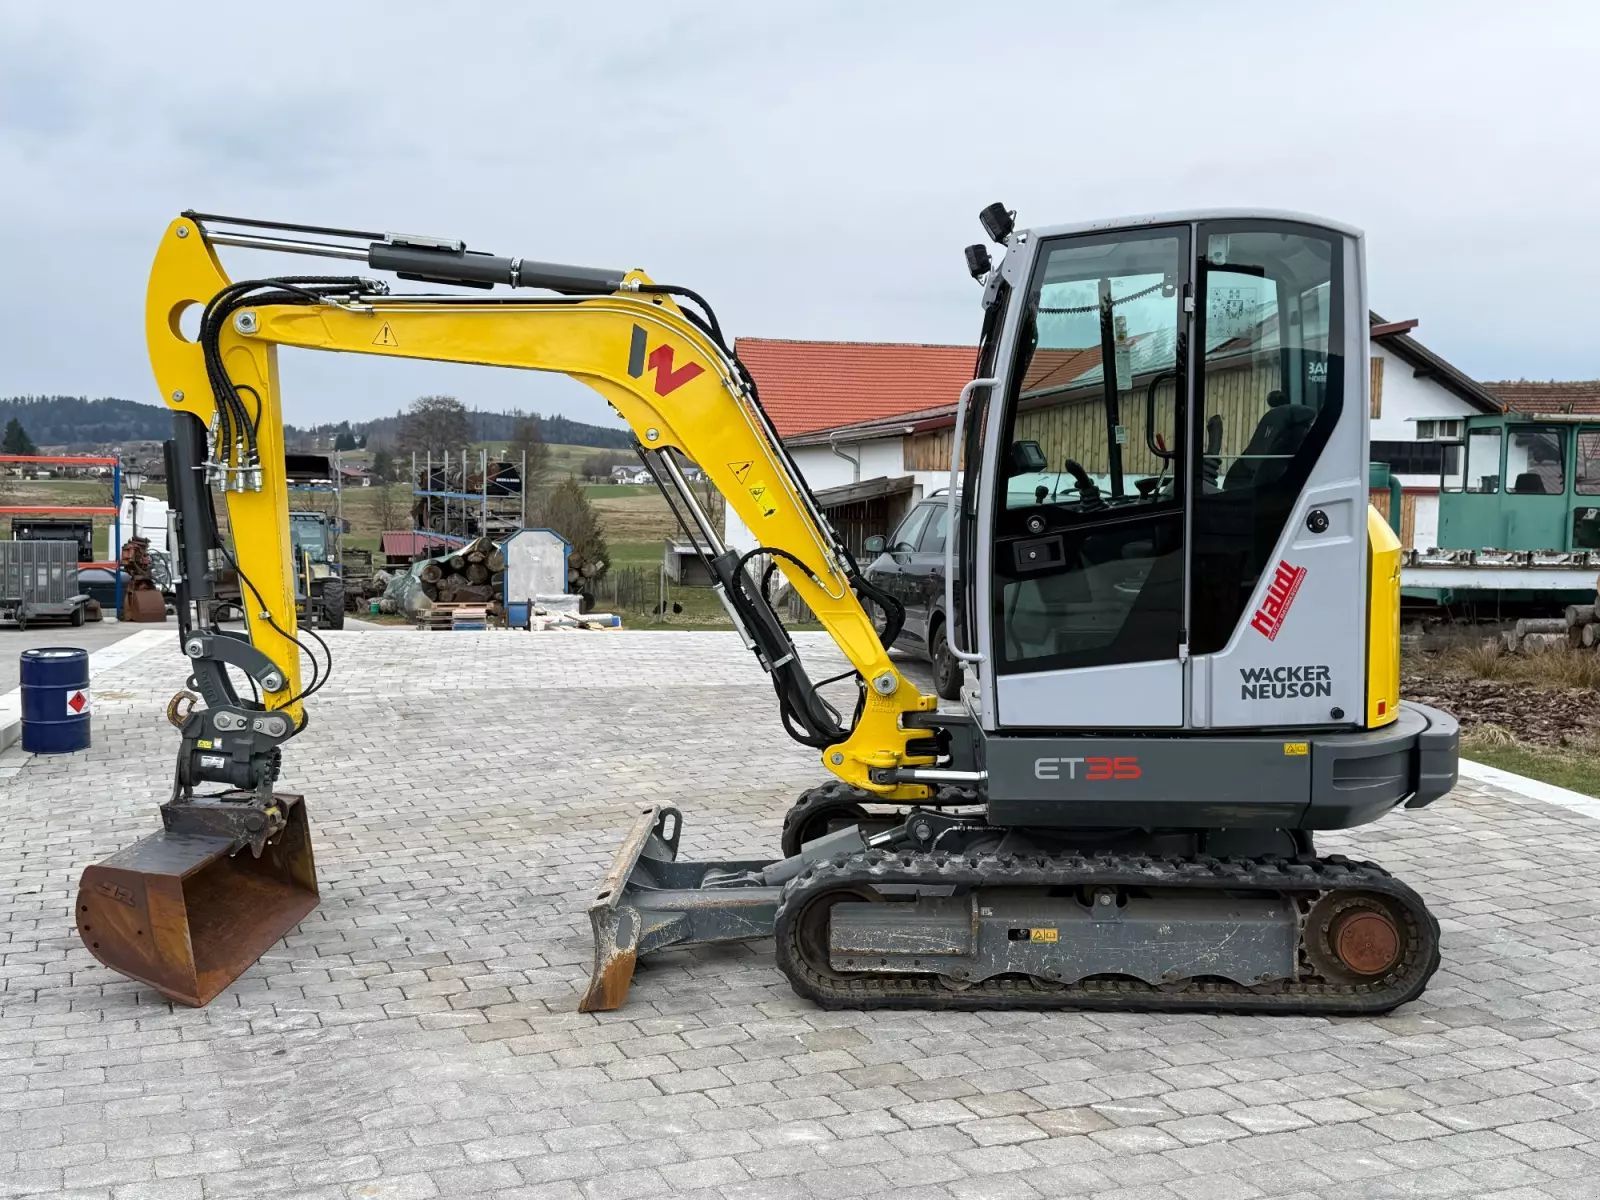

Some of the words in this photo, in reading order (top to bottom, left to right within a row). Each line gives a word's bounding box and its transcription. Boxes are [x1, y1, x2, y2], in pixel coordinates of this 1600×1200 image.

[1240, 665, 1331, 683] WACKER
[1242, 681, 1331, 700] NEUSON
[1035, 757, 1142, 780] ET35
